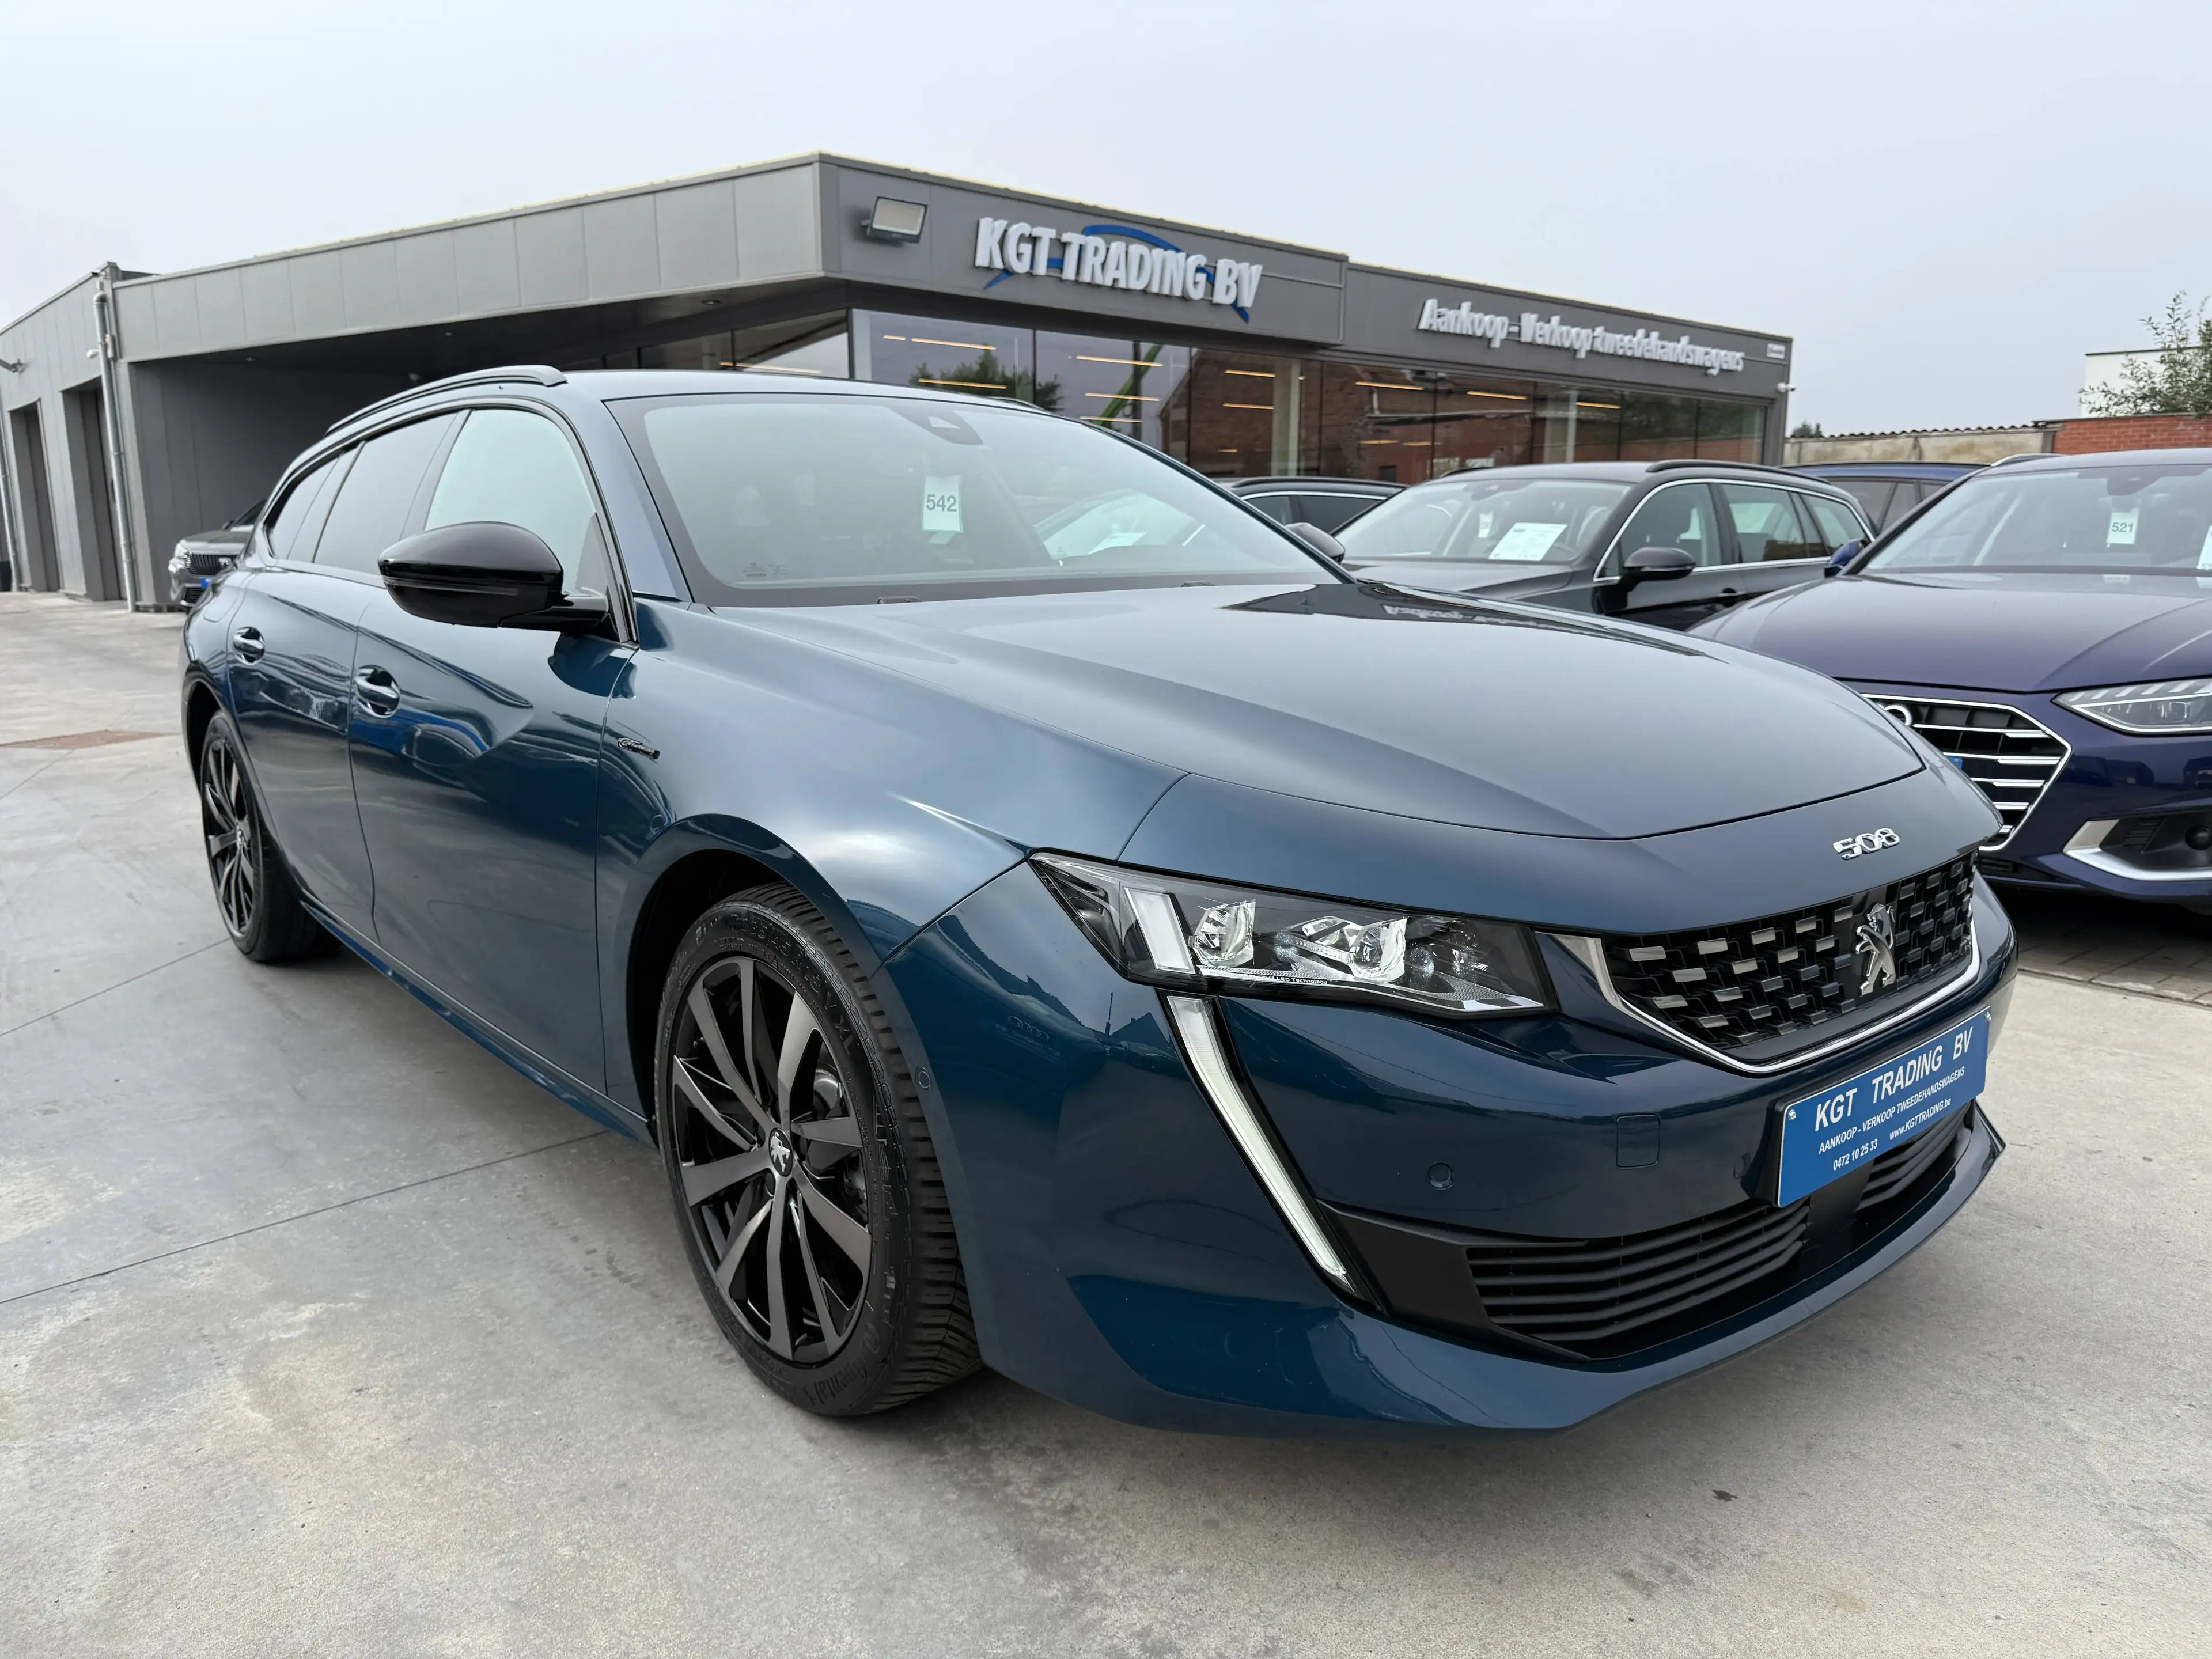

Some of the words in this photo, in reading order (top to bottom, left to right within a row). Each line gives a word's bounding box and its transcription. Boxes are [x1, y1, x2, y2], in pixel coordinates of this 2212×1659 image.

[974, 217, 1057, 276] KGT
[1060, 232, 1207, 300] TRADING
[1212, 259, 1263, 308] BV
[1418, 298, 1508, 348] Aankoop
[1520, 312, 1592, 358] Verkoop
[926, 494, 957, 512] 542
[2111, 522, 2134, 533] 521
[1832, 827, 1900, 860] 508
[1815, 1088, 1858, 1132] KGT
[1872, 1045, 1942, 1104] TRADING
[1953, 1027, 1974, 1060] BV
[1819, 1126, 1857, 1154] AANKOOP
[1862, 1105, 1896, 1132] VERKOOP
[1896, 1066, 1965, 1114] TWEEDEHANDSWAGENS
[1833, 1153, 1850, 1171] 0472
[1851, 1148, 1859, 1161] 10
[1860, 1143, 1869, 1157] 25
[1870, 1138, 1878, 1152] 33
[1889, 1097, 1952, 1141] www.KGTTRADING.be
